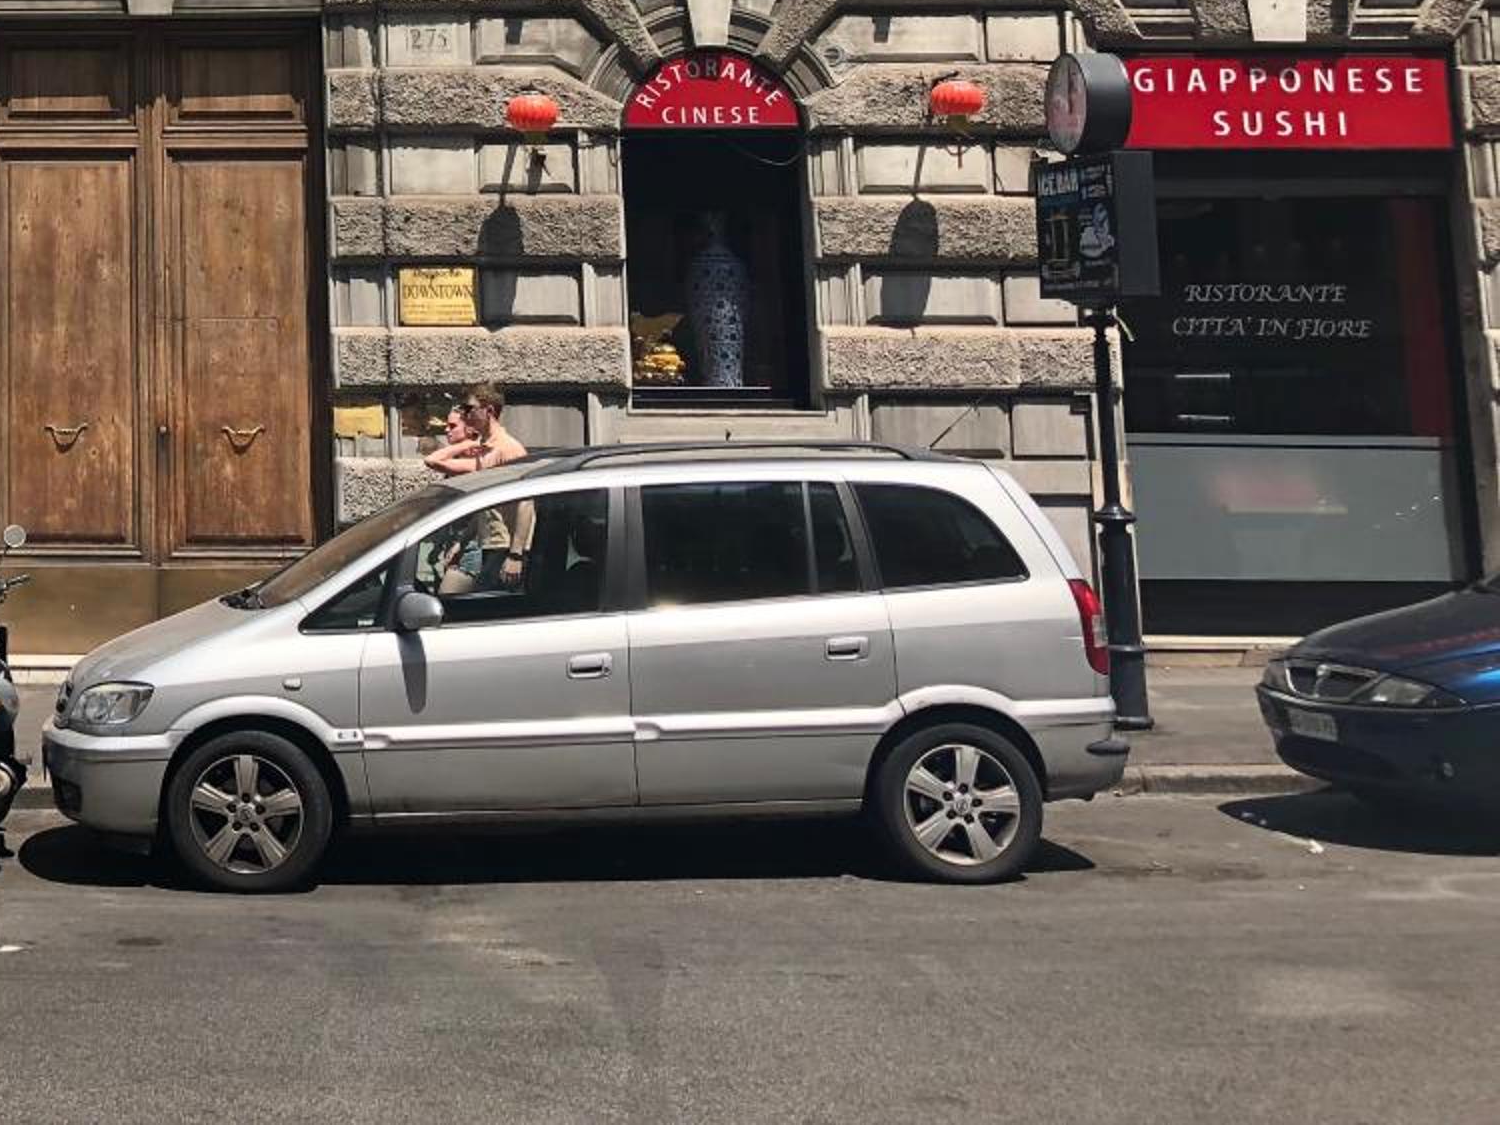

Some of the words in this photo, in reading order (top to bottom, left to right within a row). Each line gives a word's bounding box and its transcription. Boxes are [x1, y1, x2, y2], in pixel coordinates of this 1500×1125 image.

[635, 59, 784, 109] RISTORANTE
[1133, 67, 1423, 93] GIAPPONESE
[662, 106, 759, 124] CINESE
[1213, 110, 1347, 136] SUSHI
[1185, 283, 1347, 302] RISTORANTE
[1257, 318, 1292, 336] IN
[1294, 318, 1372, 339] FIORE
